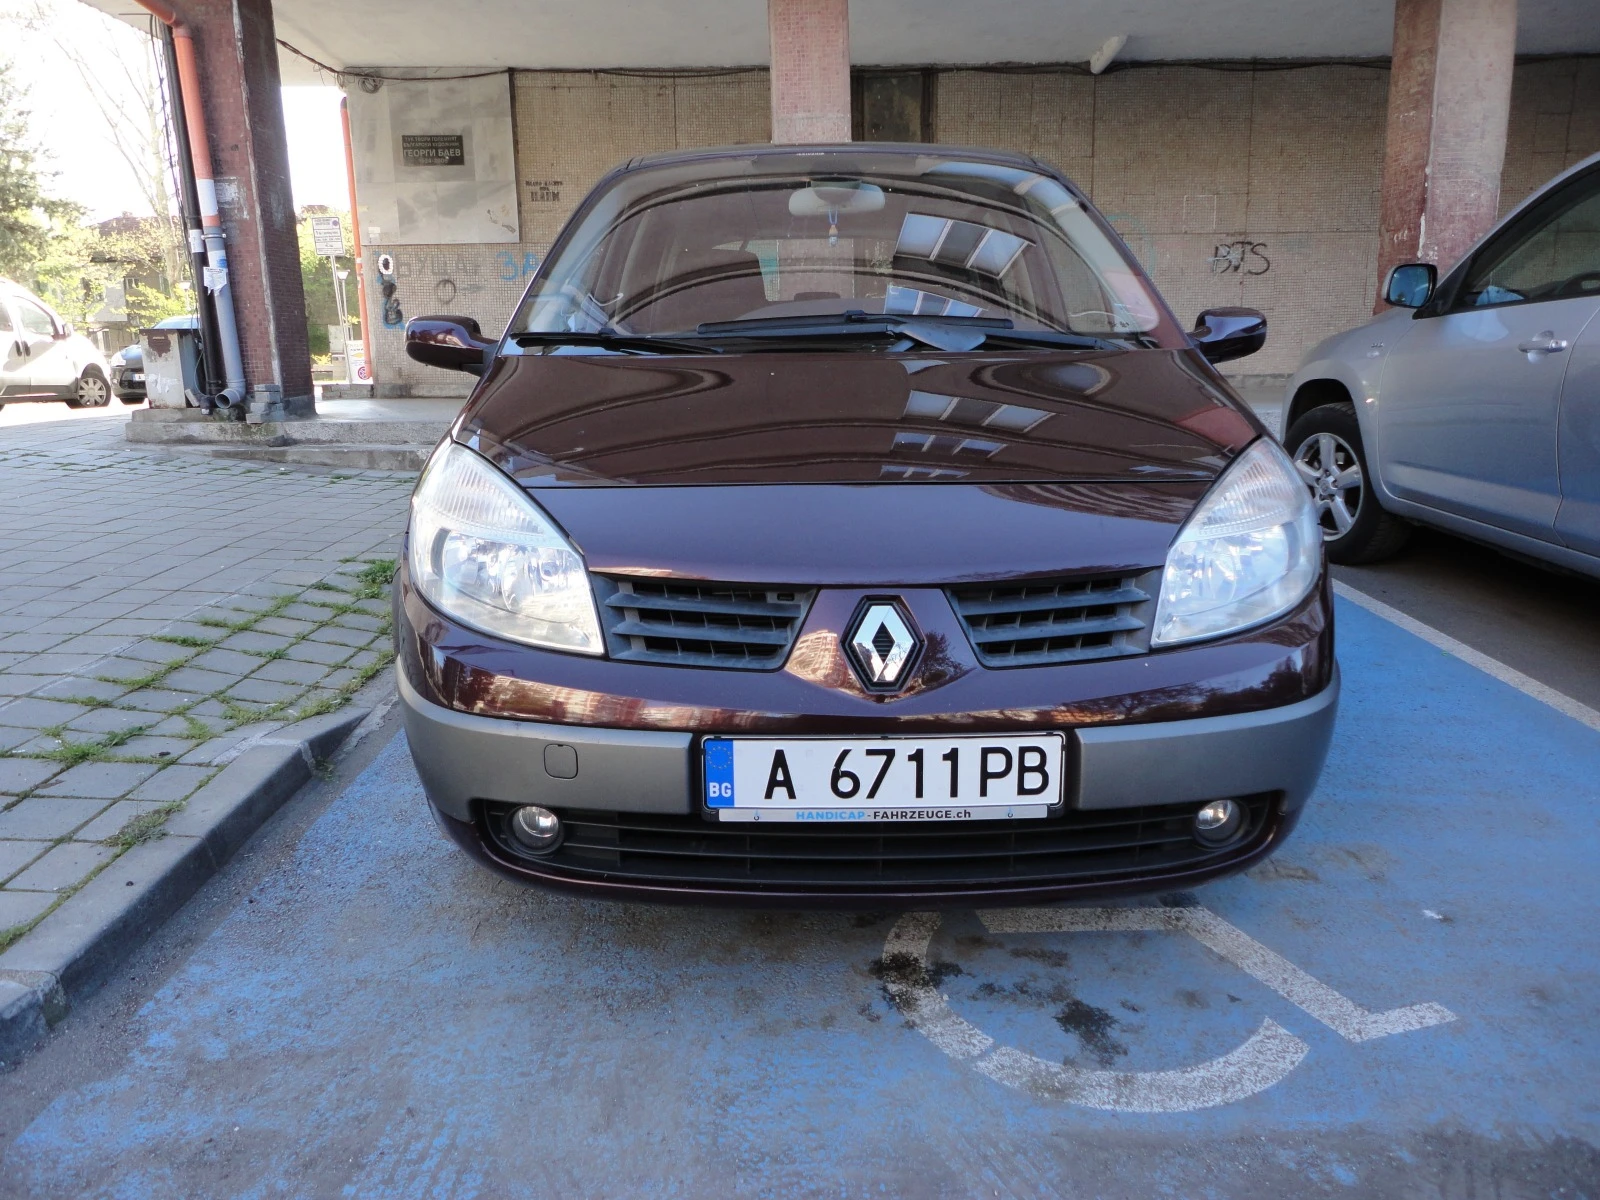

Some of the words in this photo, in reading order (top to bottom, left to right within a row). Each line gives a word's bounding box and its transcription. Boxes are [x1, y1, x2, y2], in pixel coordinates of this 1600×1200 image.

[403, 149, 436, 157] ГЕОРГИ
[438, 149, 461, 157] БАЕВ
[764, 749, 797, 800] A
[709, 783, 732, 797] BG
